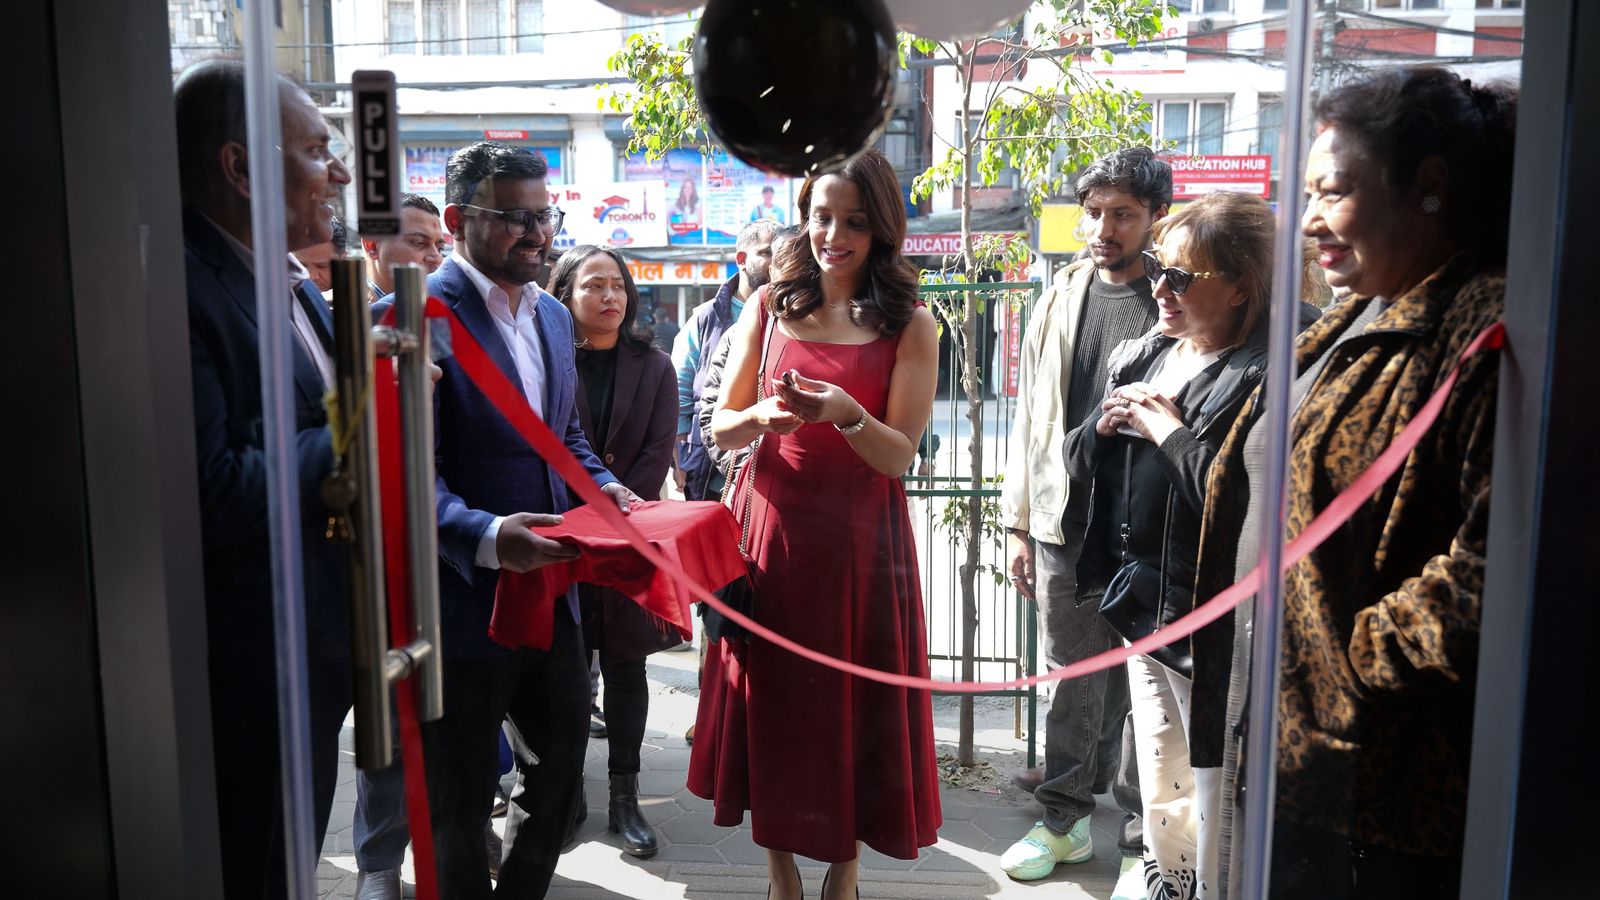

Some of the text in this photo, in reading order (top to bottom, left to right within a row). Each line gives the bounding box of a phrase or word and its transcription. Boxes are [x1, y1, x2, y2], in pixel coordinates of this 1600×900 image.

[363, 102, 386, 204] PULL
[1241, 159, 1267, 170] HUB
[608, 212, 657, 222] TORONTO
[552, 238, 576, 247] ARK
[903, 238, 964, 252] DUCATIO
